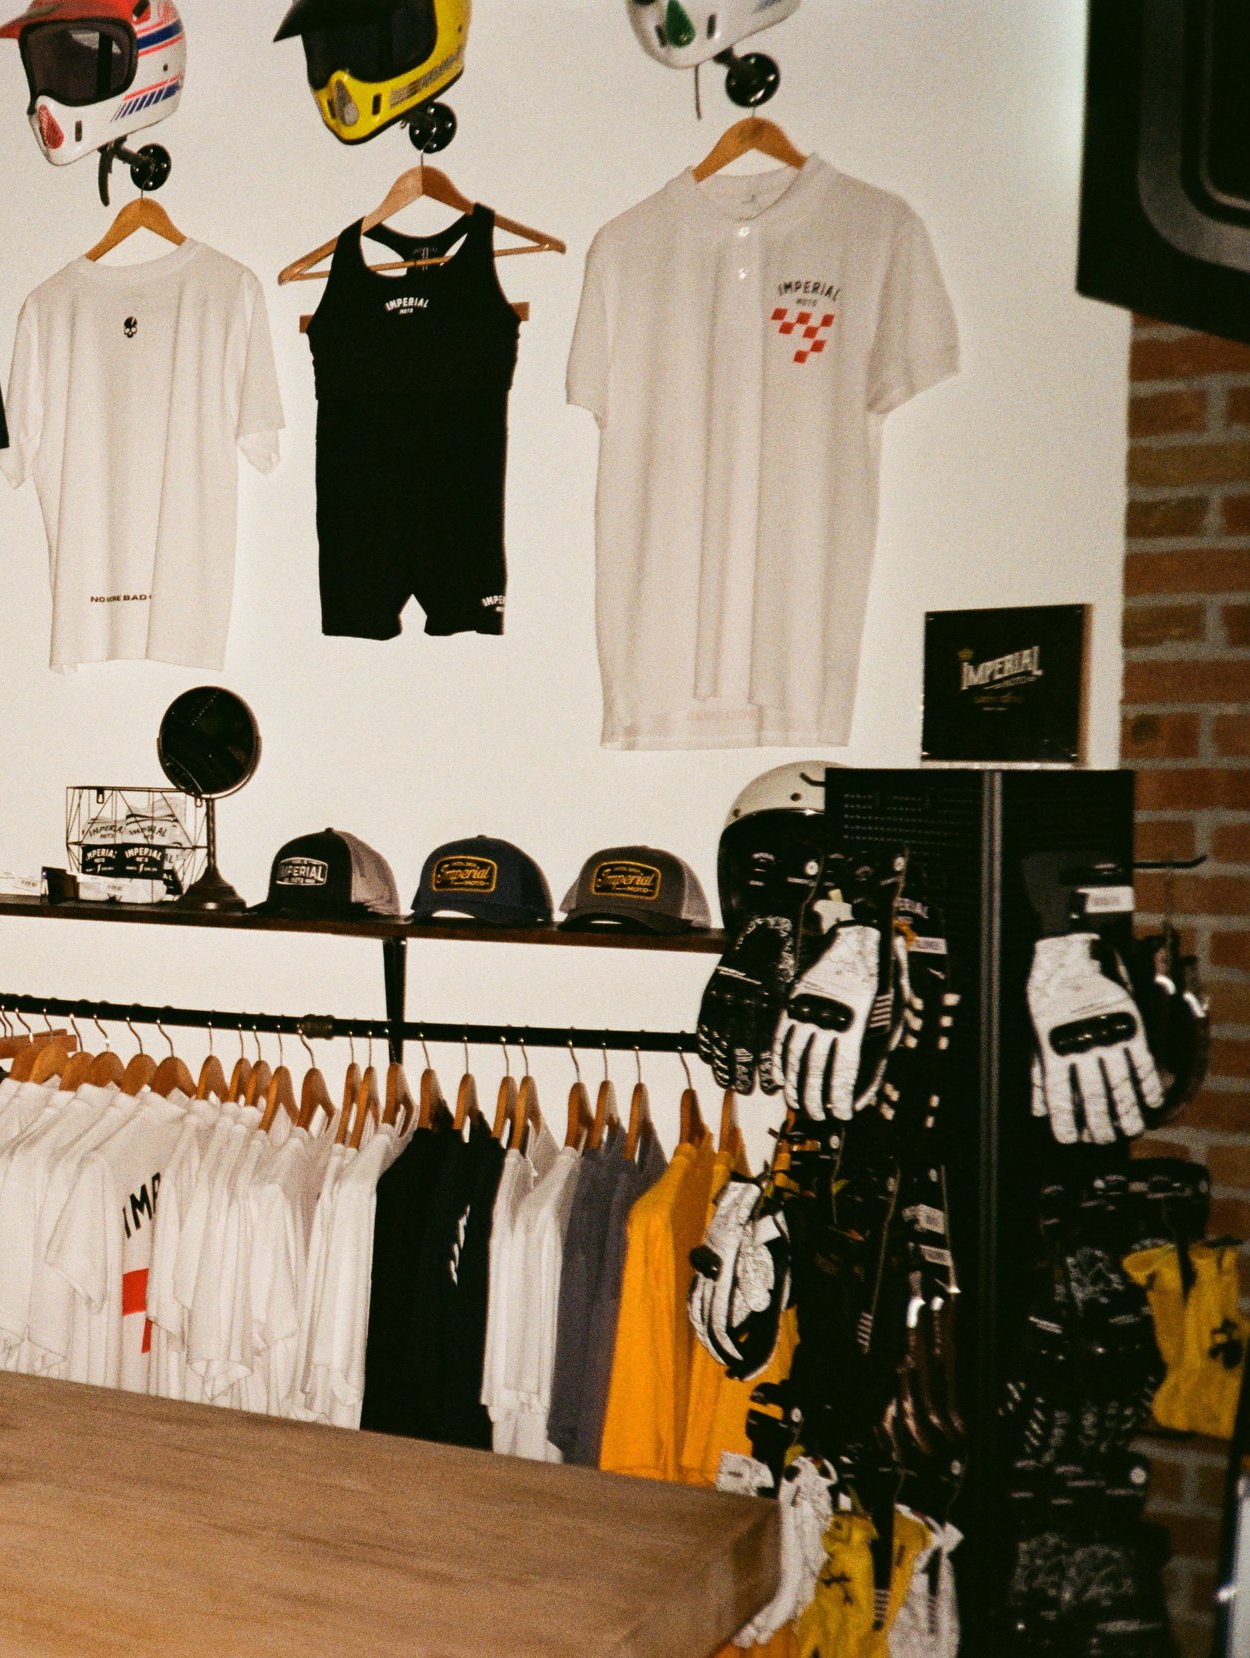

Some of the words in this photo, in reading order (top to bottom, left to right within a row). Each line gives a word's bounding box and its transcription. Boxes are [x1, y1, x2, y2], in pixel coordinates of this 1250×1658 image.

[777, 281, 840, 302] IMPERIAL
[385, 297, 429, 311] IMPERIAL
[960, 646, 1044, 690] IMPERIAL
[86, 848, 118, 861] MPERIA
[125, 847, 162, 860] IMPERIAL
[436, 864, 491, 884] Imperial
[596, 868, 656, 889] Imperial
